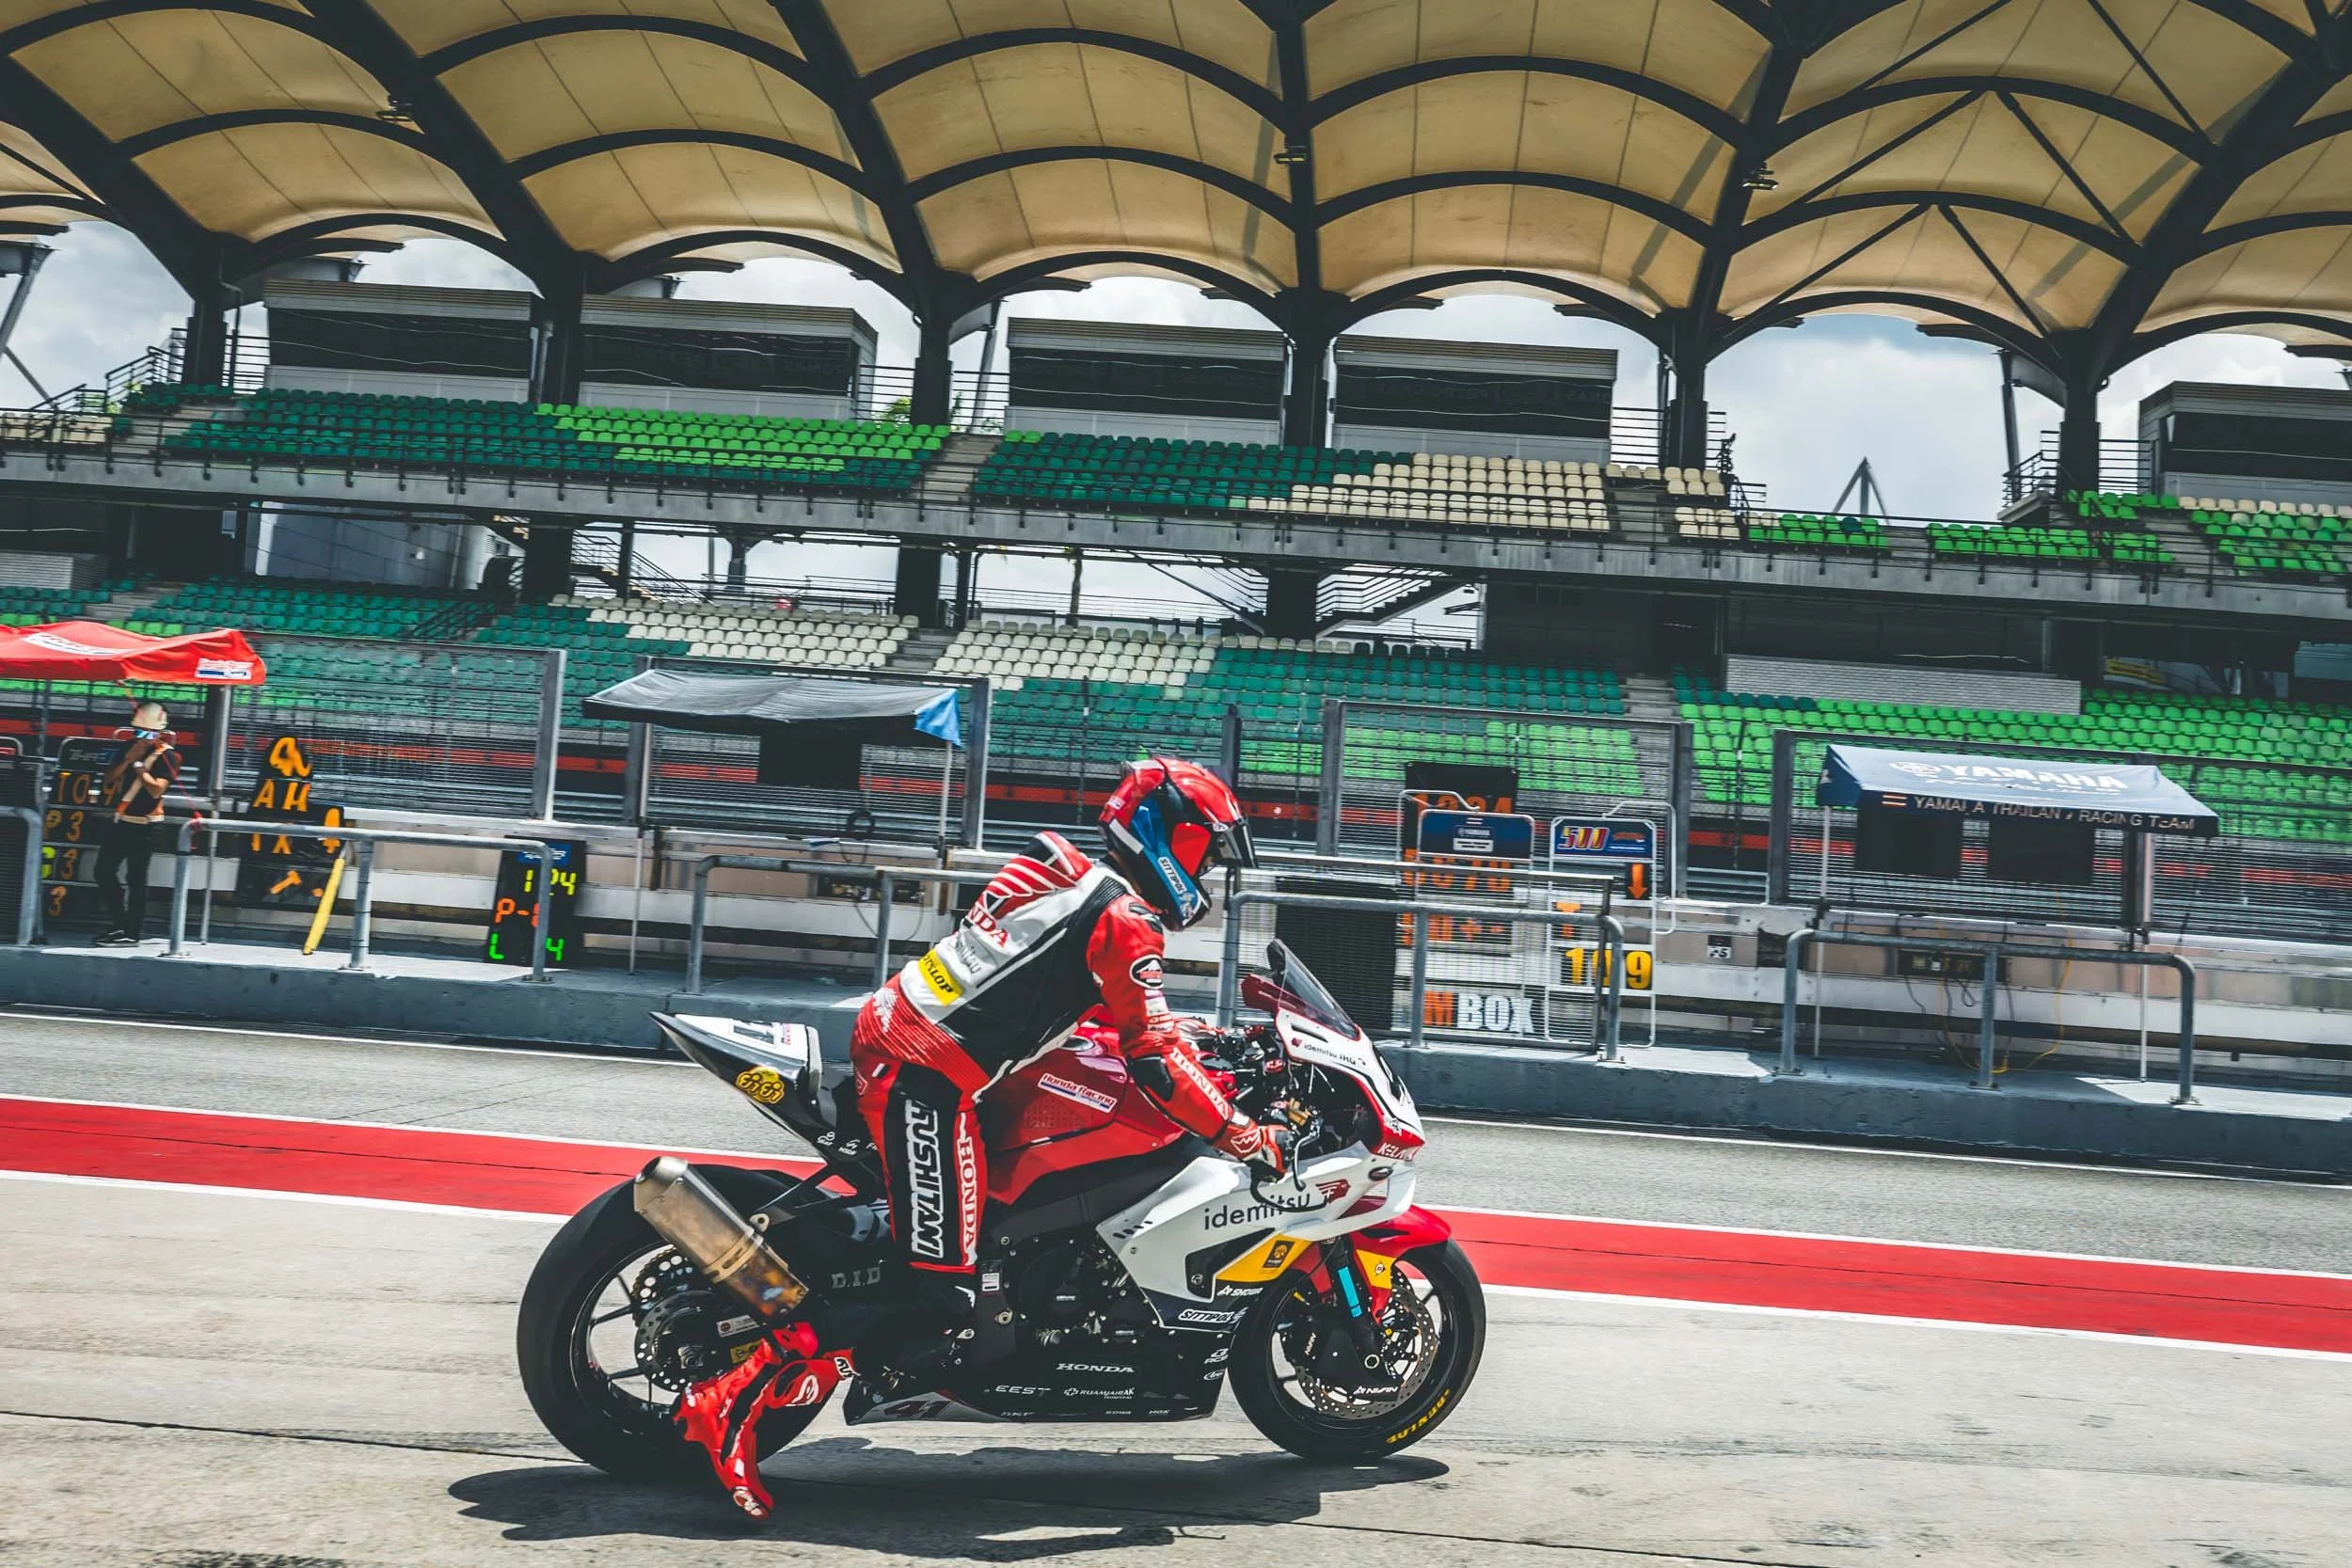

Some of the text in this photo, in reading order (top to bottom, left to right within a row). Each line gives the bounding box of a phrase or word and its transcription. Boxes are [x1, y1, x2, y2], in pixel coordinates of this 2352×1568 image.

[1939, 764, 2129, 789] YAMAHA
[1992, 801, 2074, 821] THAILAN
[959, 1139, 978, 1249] HONDA
[1203, 1193, 1311, 1231] idemitsu
[1056, 1363, 1136, 1373] HONDA
